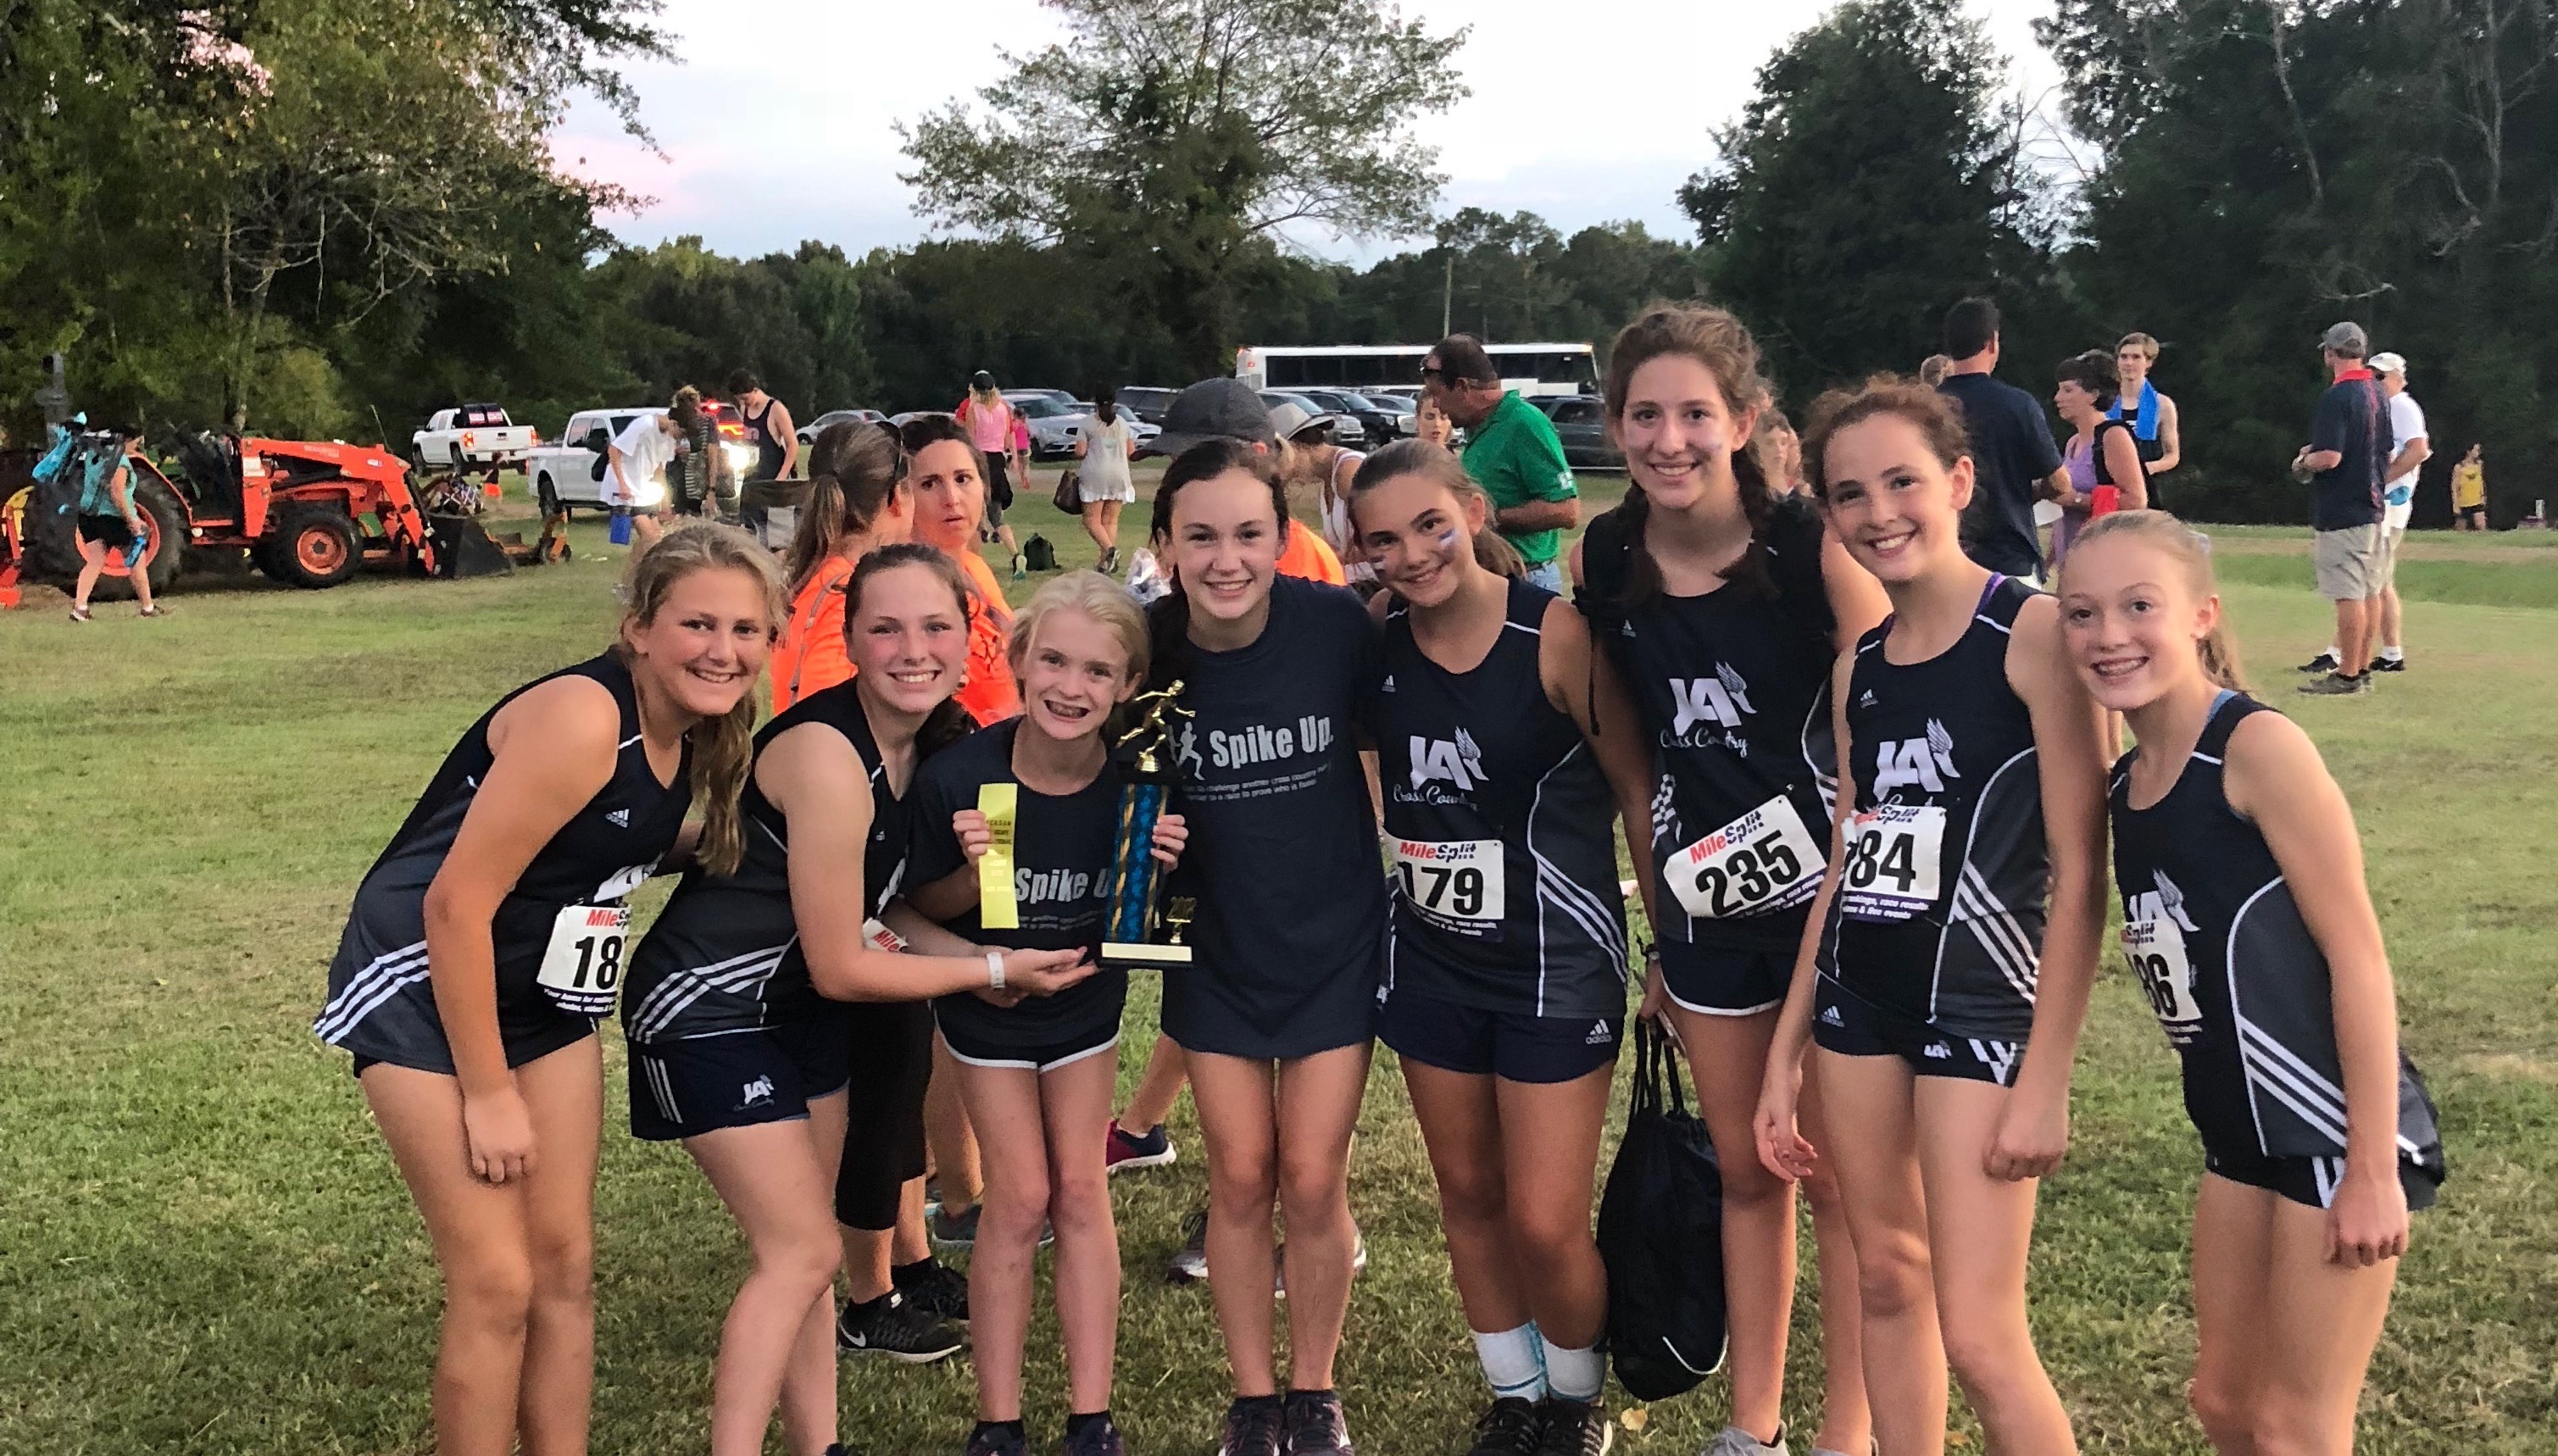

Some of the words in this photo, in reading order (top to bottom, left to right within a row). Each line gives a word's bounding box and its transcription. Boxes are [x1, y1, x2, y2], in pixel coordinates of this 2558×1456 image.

[1209, 725, 1293, 769] Spike
[1399, 842, 1476, 863] MileSplit
[1689, 810, 1765, 864] MileSplit
[1015, 867, 1088, 904] Spike
[1093, 869, 1113, 898] U
[1397, 861, 1484, 916] 179
[1695, 829, 1802, 916] 235
[572, 935, 628, 990] 18
[2125, 953, 2178, 1018] 86
